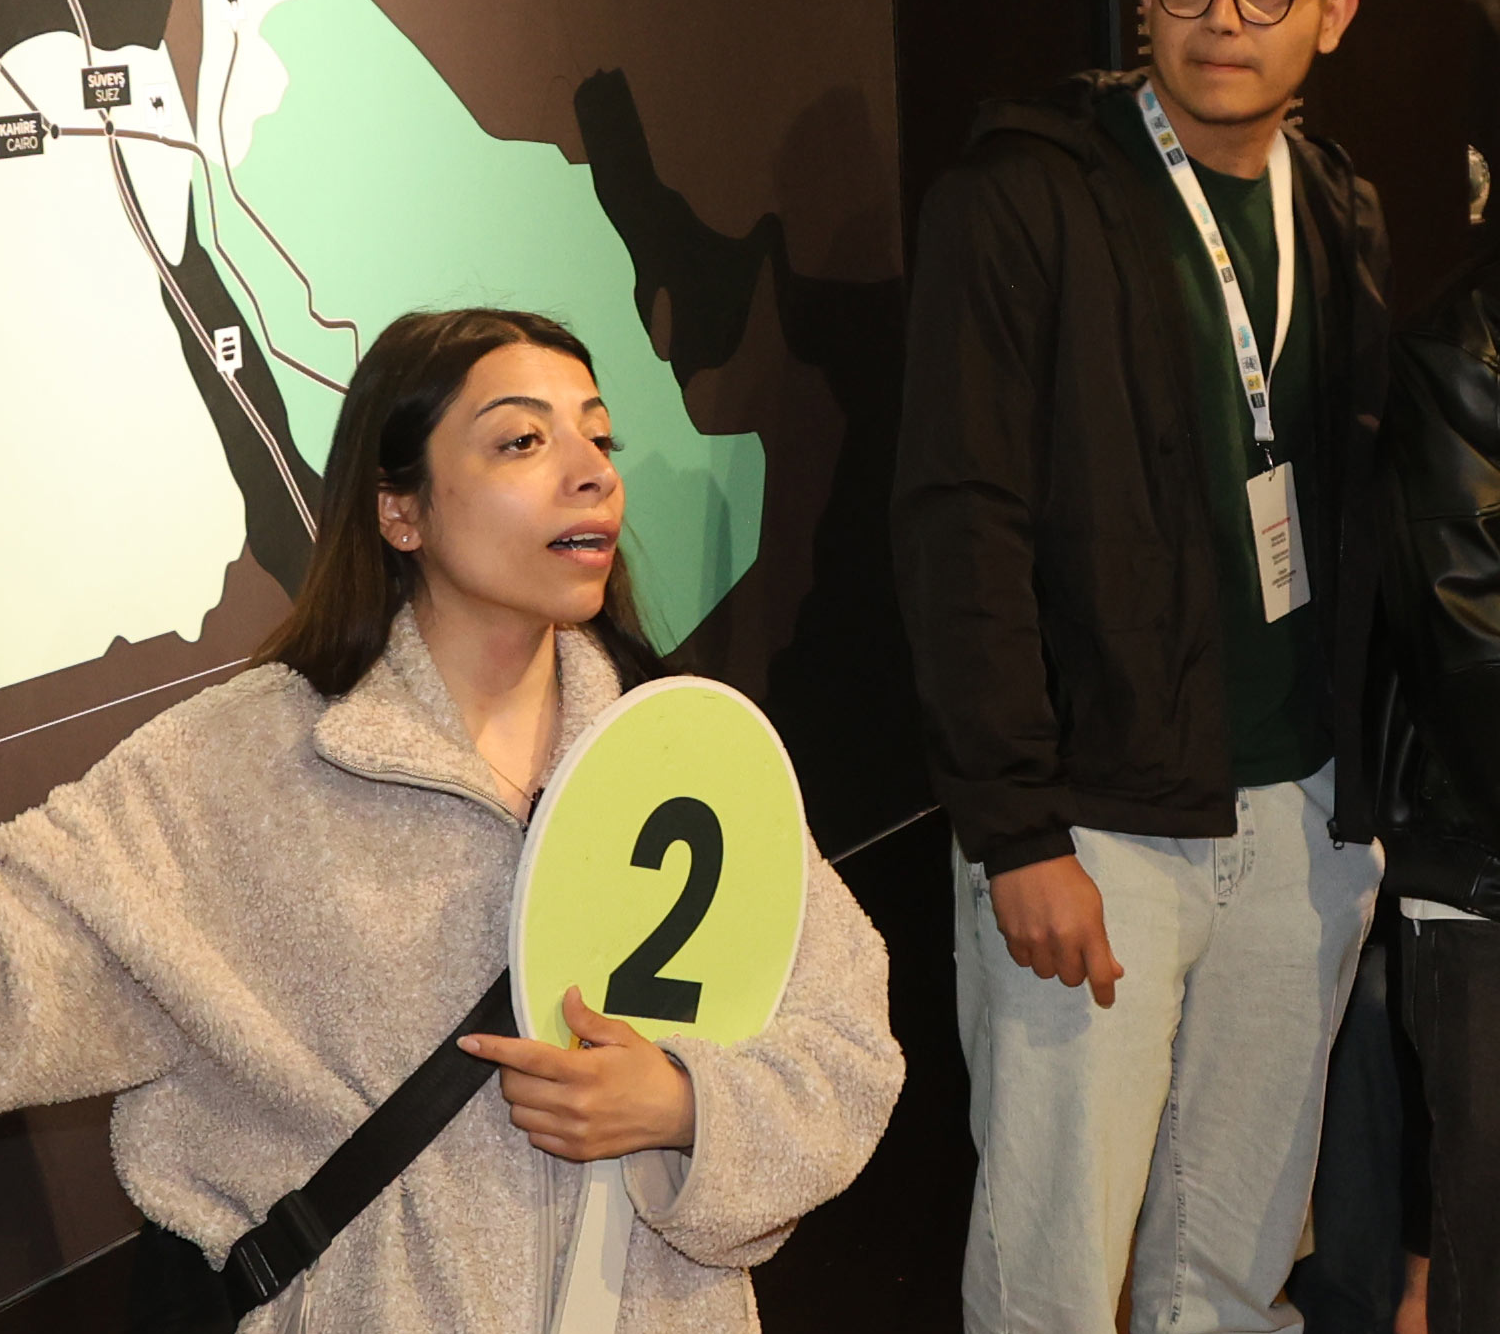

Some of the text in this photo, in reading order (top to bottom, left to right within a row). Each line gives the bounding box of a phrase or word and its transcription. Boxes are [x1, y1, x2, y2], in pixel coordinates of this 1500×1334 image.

[95, 88, 120, 102] SUEZ
[6, 135, 38, 153] CAIRO
[603, 796, 725, 1024] 2
